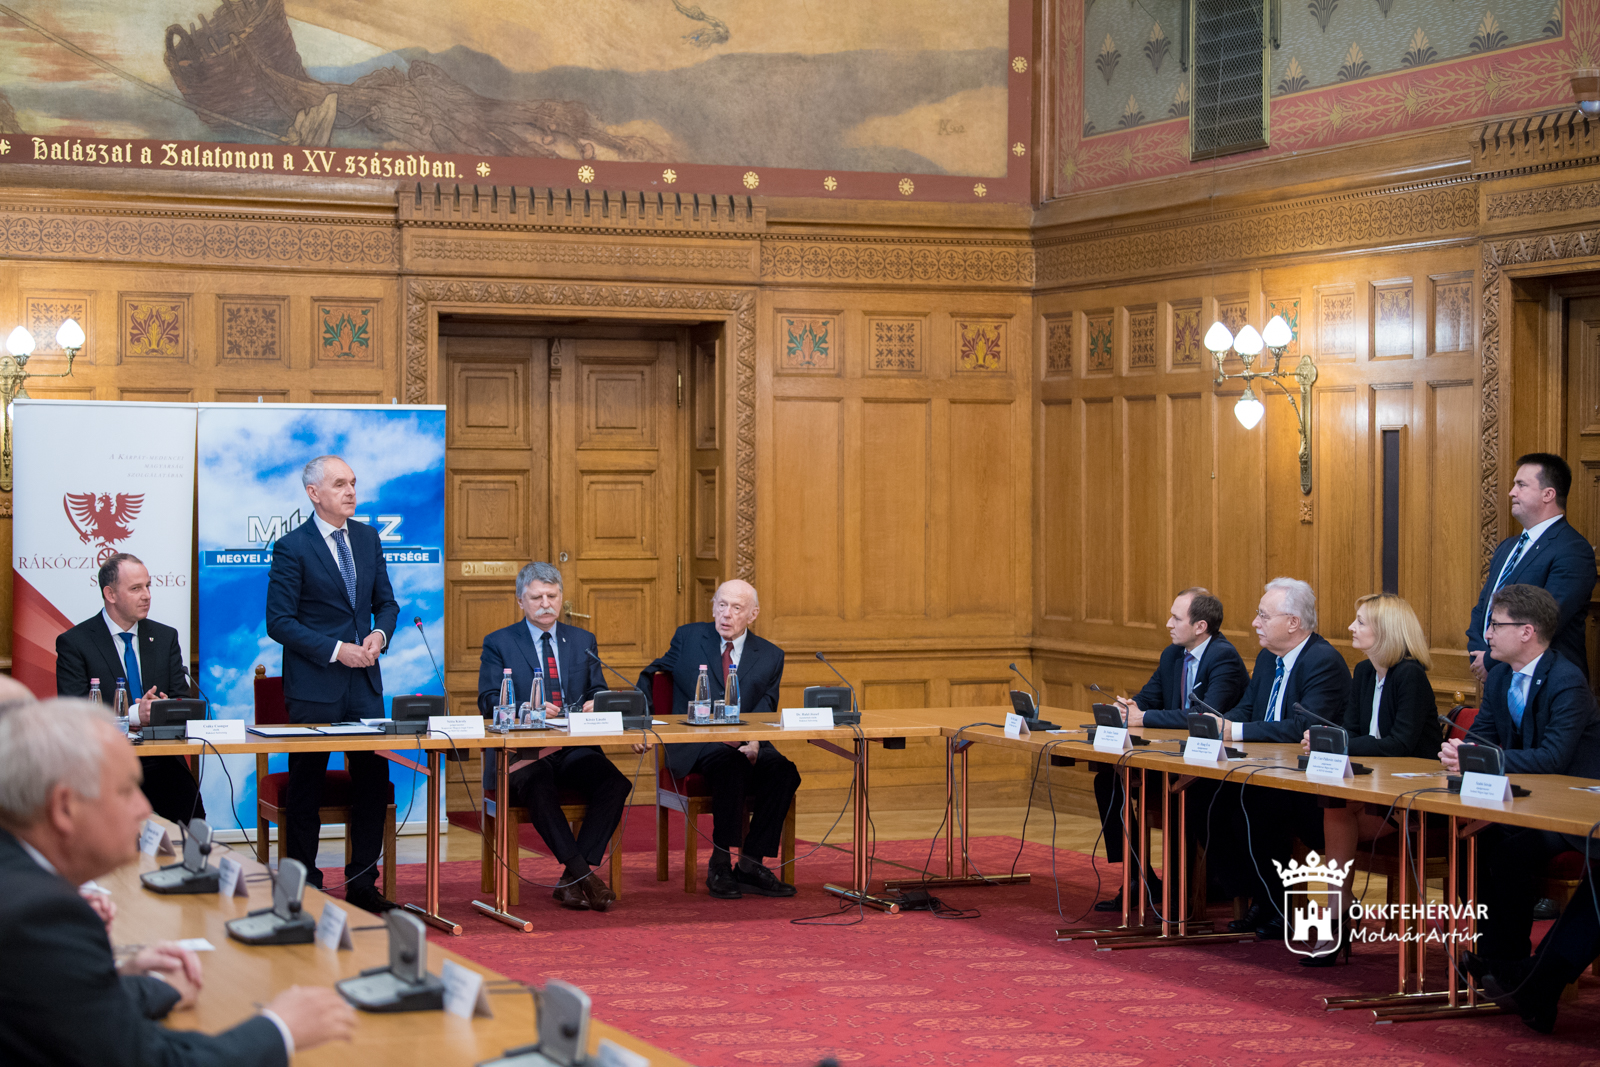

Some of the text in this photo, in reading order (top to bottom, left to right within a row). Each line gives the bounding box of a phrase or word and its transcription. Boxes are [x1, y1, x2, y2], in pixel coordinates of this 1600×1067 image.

[140, 146, 153, 165] a
[160, 143, 274, 171] Balatonon
[283, 152, 295, 171] a
[18, 553, 95, 569] RÁKÓCZI
[216, 554, 261, 563] MEGYEI
